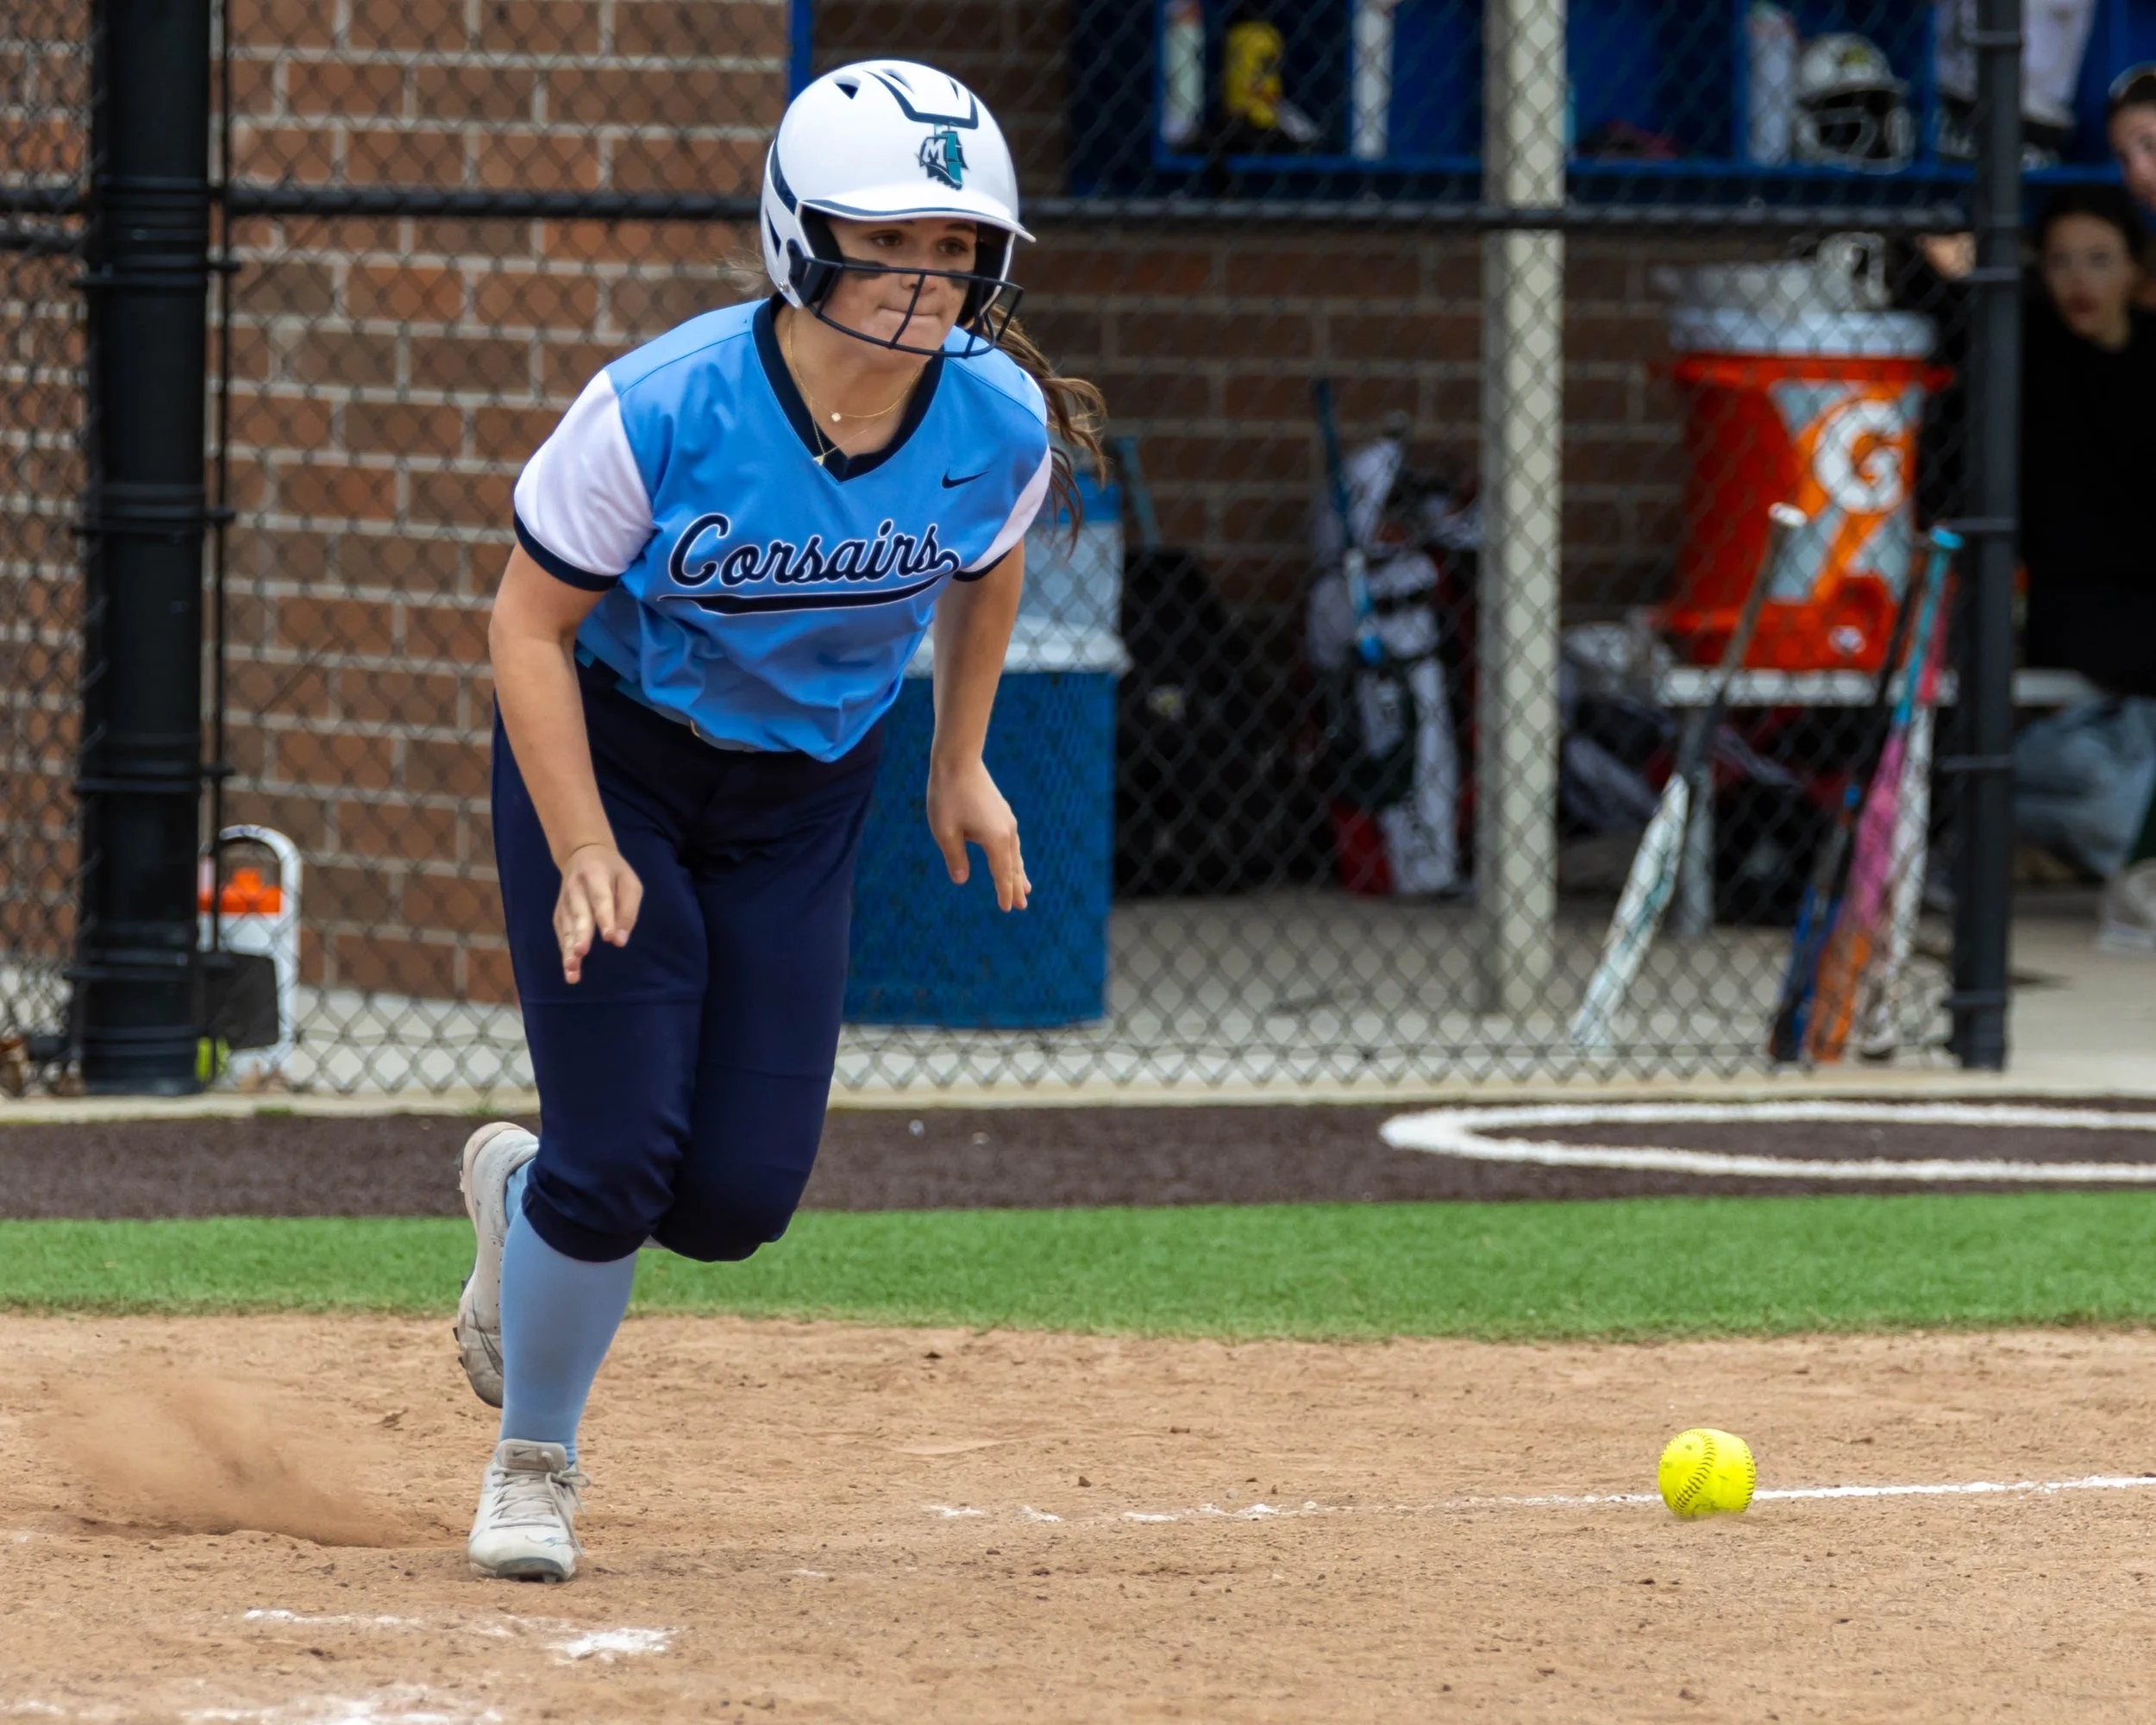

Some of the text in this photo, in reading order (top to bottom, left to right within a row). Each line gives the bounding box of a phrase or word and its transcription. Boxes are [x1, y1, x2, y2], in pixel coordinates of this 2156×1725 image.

[922, 138, 947, 169] M
[1814, 398, 1902, 515] G
[668, 511, 960, 587] Corsairs
